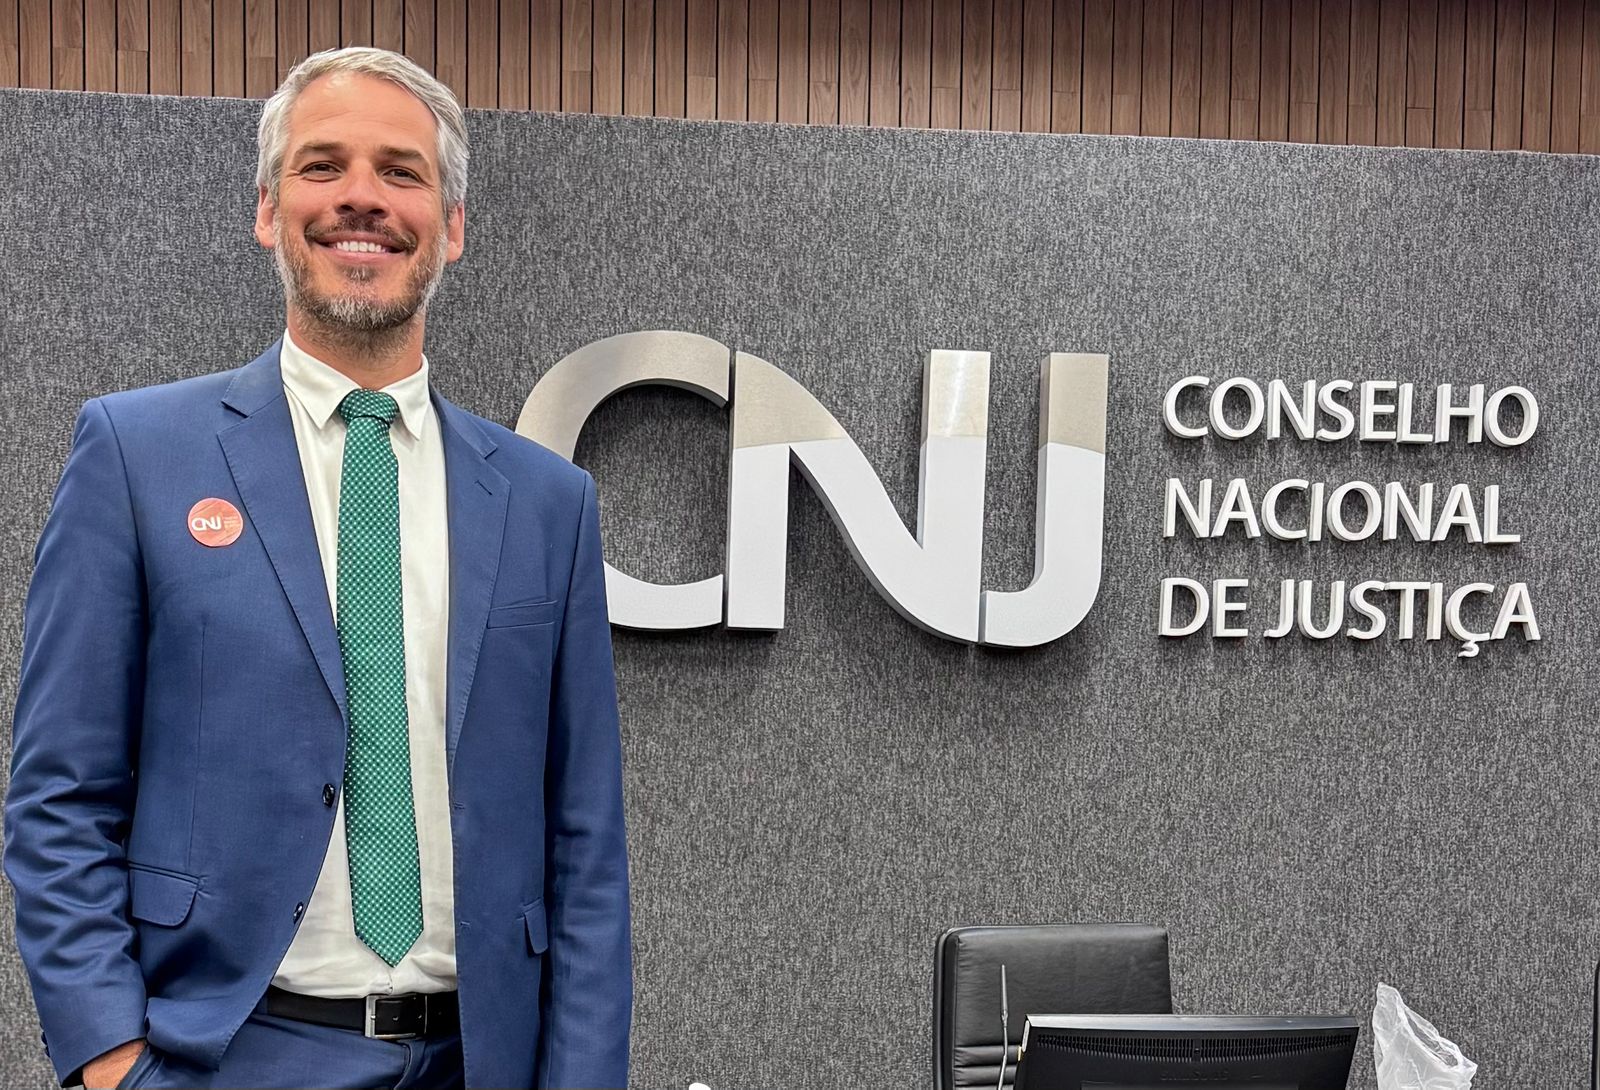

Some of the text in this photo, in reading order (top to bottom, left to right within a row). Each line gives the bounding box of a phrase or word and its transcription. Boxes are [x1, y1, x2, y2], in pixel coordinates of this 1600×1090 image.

[1163, 375, 1539, 447] CONSELHO
[515, 329, 1109, 648] CNJ
[1163, 478, 1521, 544] NACIONAL
[1158, 577, 1541, 658] DE JUSTIÇA
